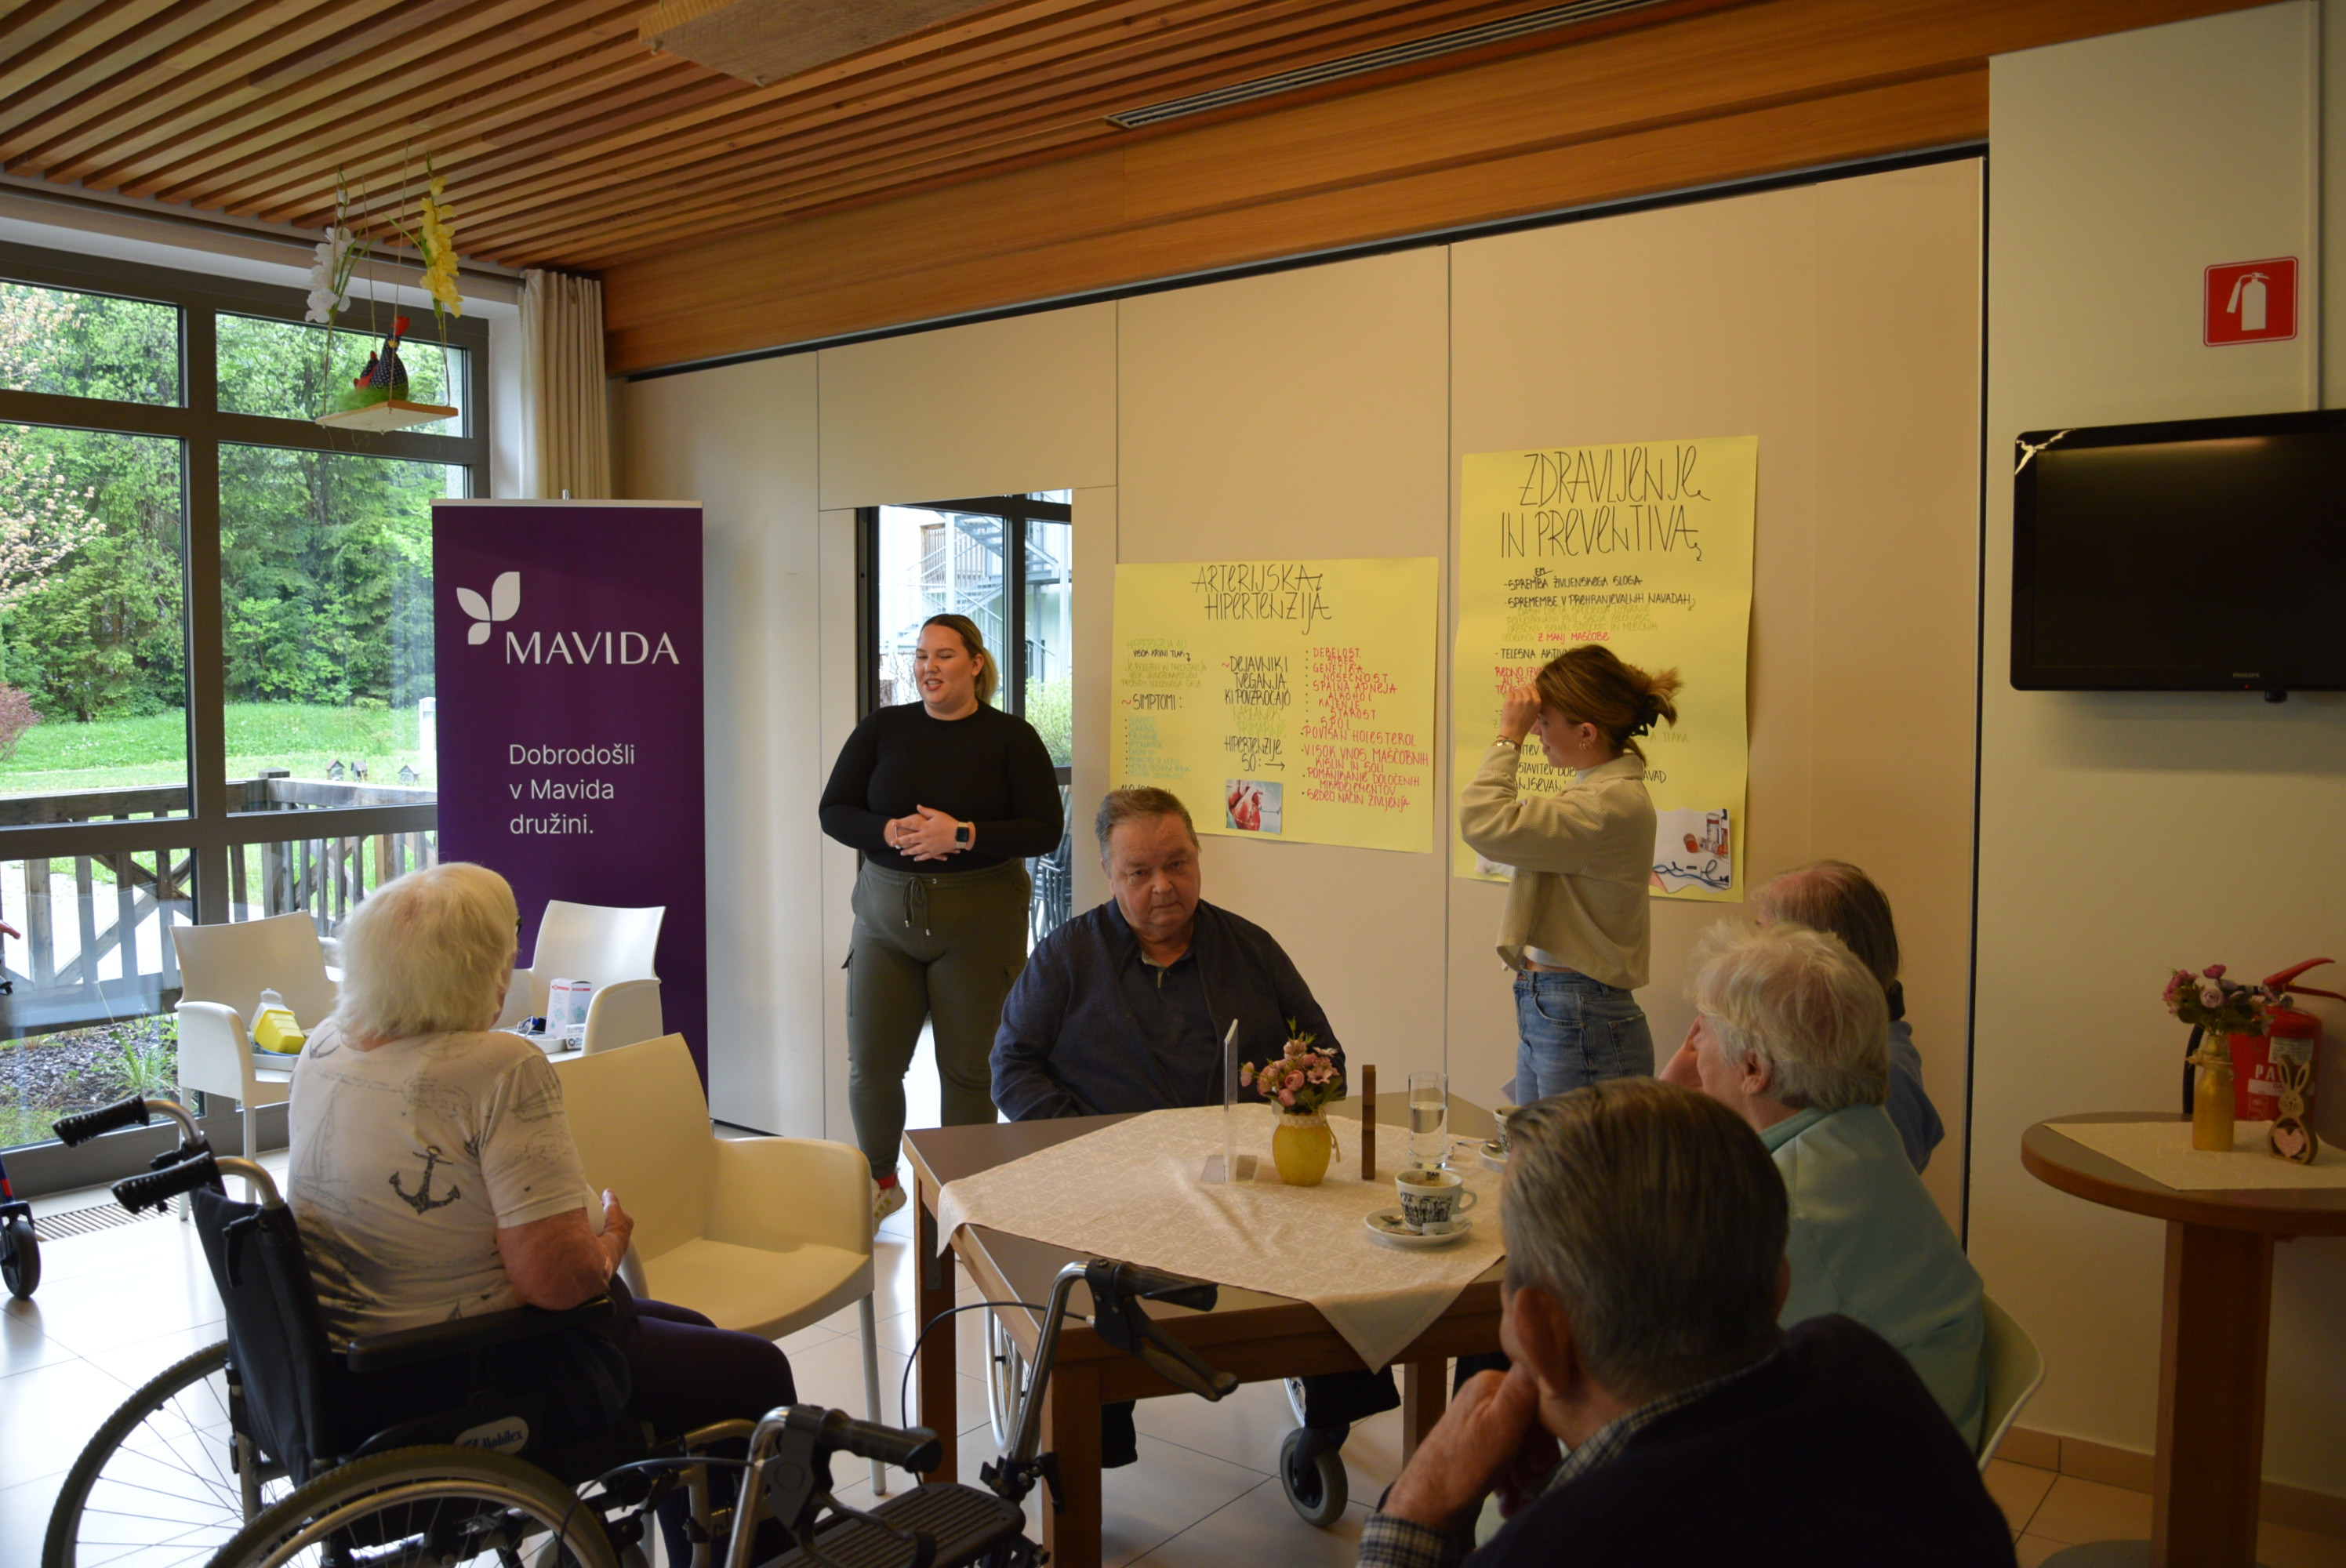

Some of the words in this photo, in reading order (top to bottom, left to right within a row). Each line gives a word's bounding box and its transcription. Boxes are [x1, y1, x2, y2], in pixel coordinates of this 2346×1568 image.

[1502, 512, 1525, 558] IN
[1613, 575, 1643, 586] SLOGA
[1561, 596, 1567, 606] V
[1538, 632, 1543, 642] Z
[1546, 633, 1566, 644] MANJ
[507, 631, 680, 665] MAVIDA
[1328, 691, 1372, 702] ALKOHOL
[1331, 706, 1376, 720] STAROST
[1320, 717, 1350, 730] SPOL
[510, 742, 635, 765] Dobrodošli
[1304, 744, 1335, 758] VISOK
[1340, 746, 1367, 761] VNOS
[1351, 760, 1359, 771] IN
[1364, 761, 1383, 773] SOLI
[510, 784, 522, 800] v
[531, 779, 615, 800] Mavida
[510, 813, 594, 835] družini.
